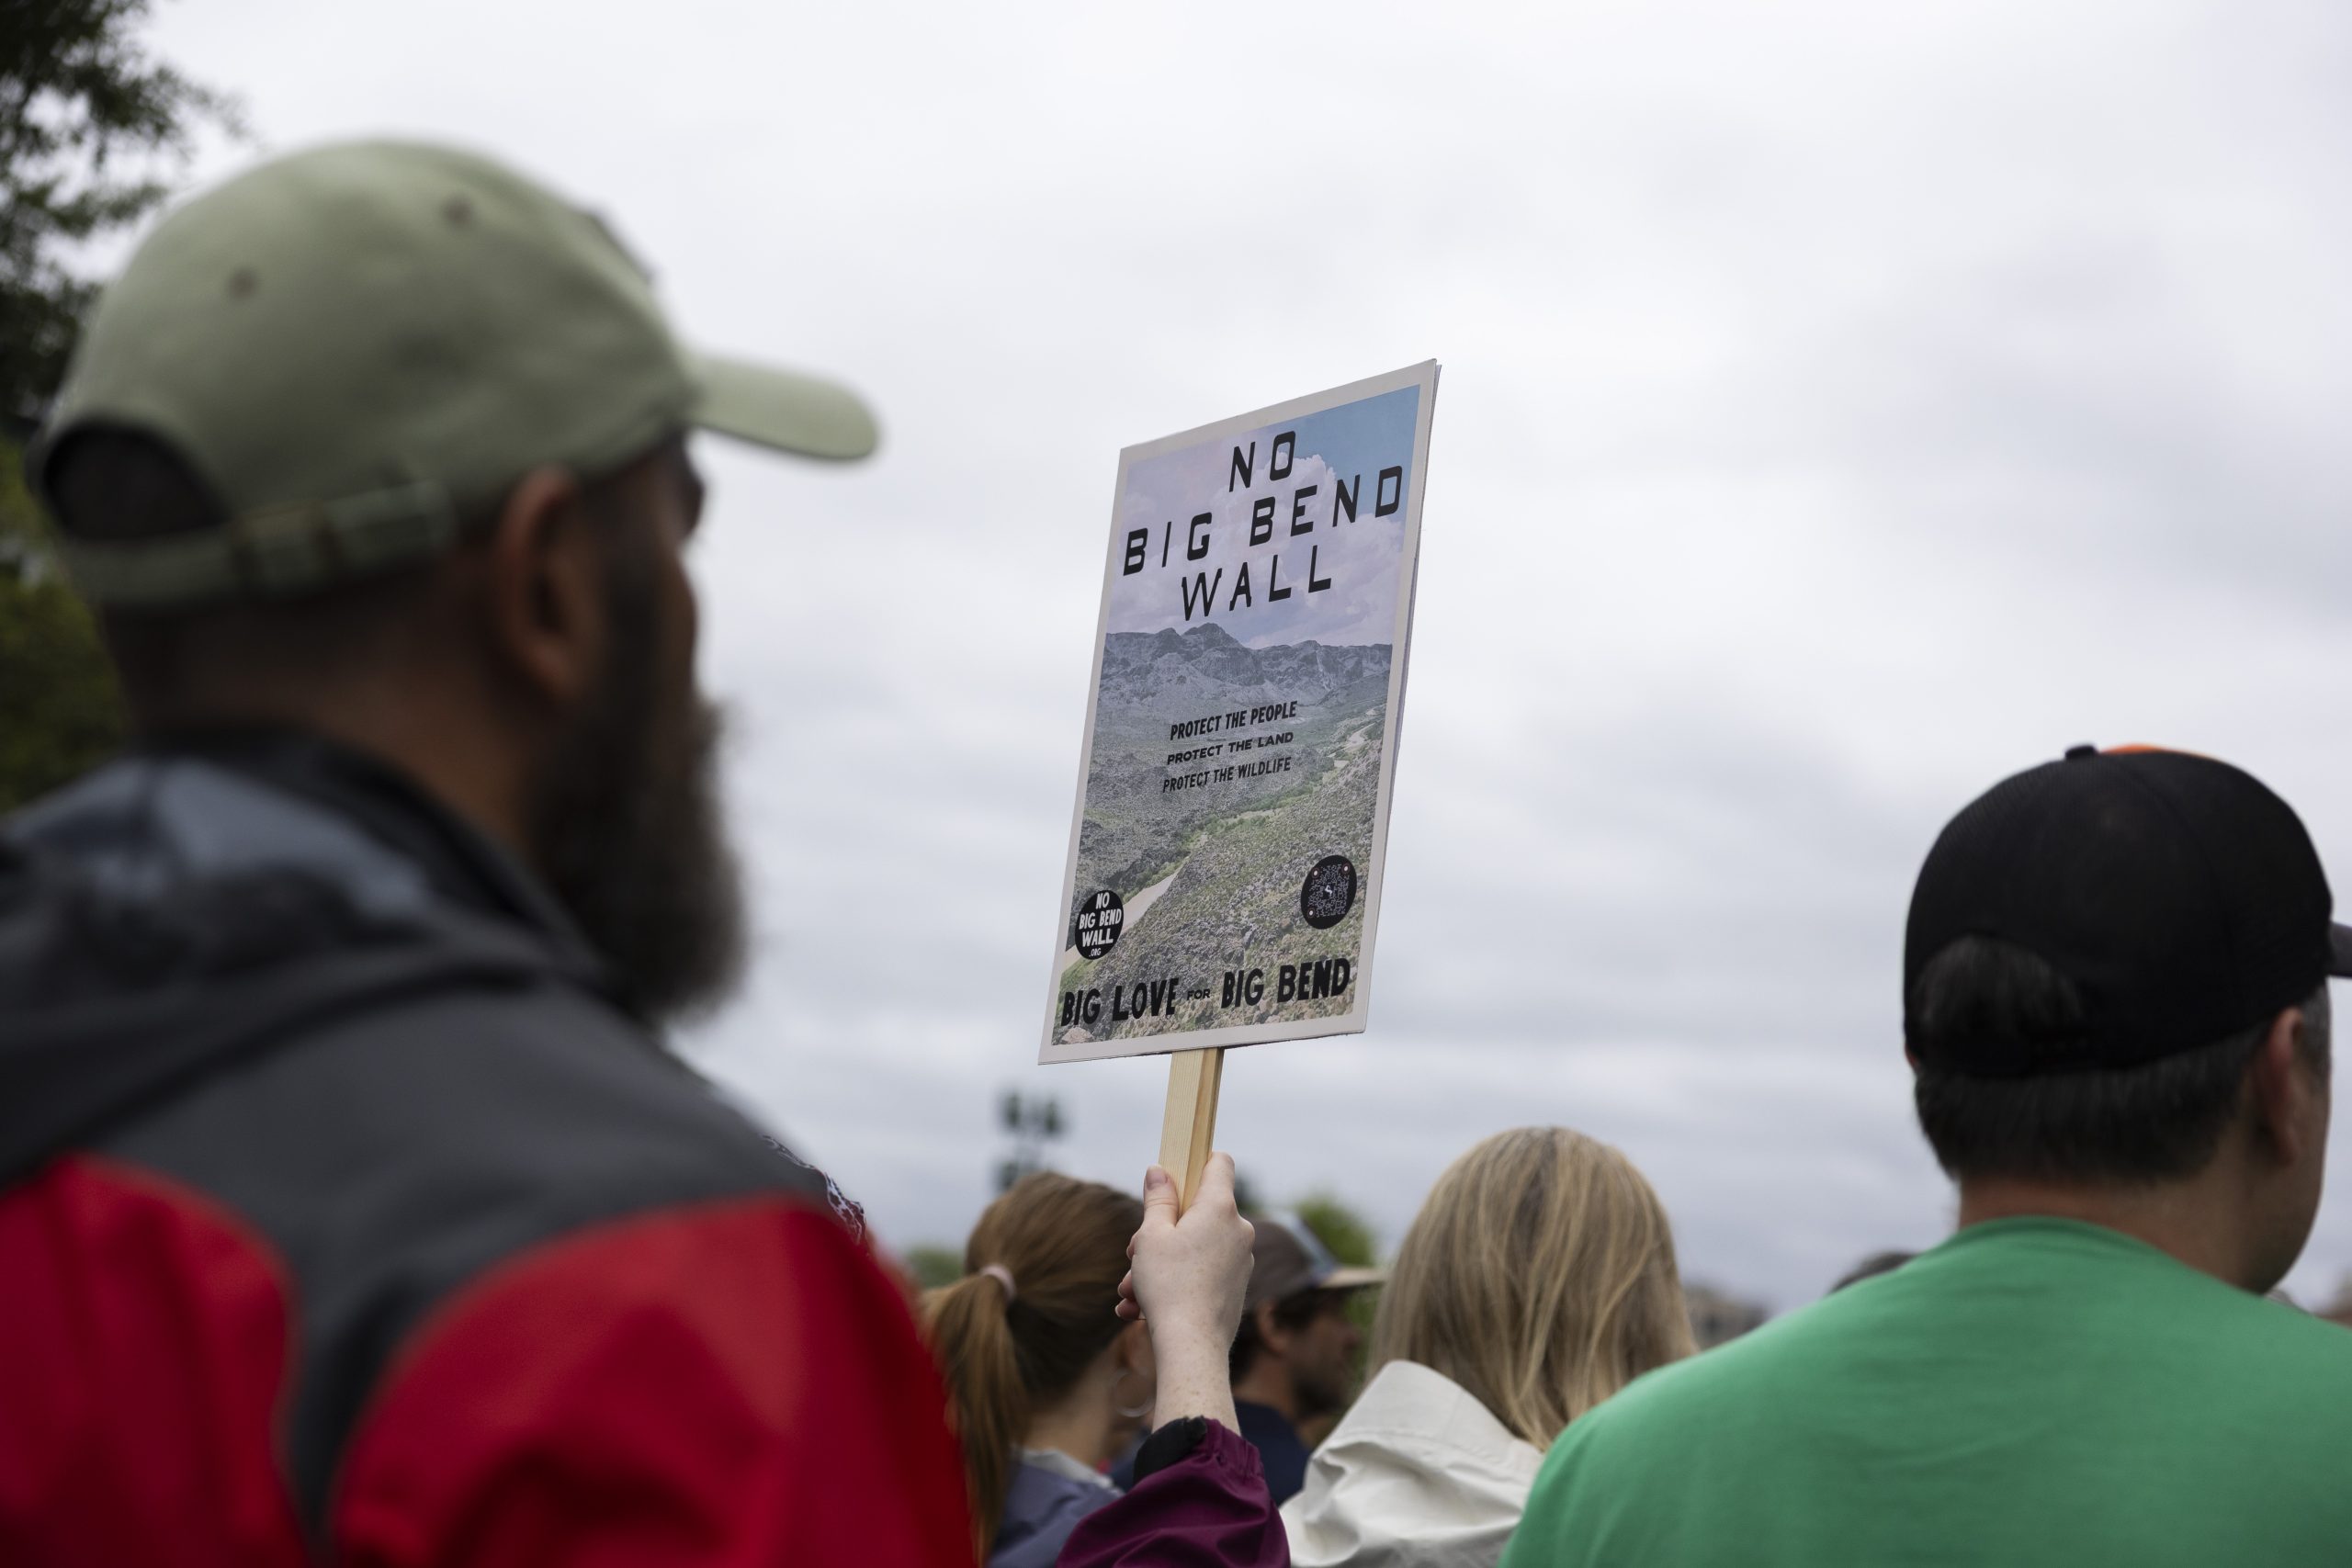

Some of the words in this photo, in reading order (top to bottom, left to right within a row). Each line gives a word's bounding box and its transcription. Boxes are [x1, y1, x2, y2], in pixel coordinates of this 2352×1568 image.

[1229, 431, 1295, 491] NO
[1124, 513, 1212, 576] BIG
[1250, 466, 1402, 547] BEND
[1182, 545, 1332, 621] WALL
[1170, 716, 1222, 740] PROTECT
[1226, 710, 1248, 729] THE
[1250, 701, 1297, 725] PEOPLE
[1167, 745, 1223, 765] PROTECT
[1228, 739, 1252, 752] THE
[1258, 732, 1294, 748] LAND
[1163, 771, 1210, 793] PROTECT
[1214, 766, 1234, 784] THE
[1238, 756, 1291, 779] WILDLIFE
[1096, 892, 1110, 908] NO
[1079, 912, 1096, 930] BIG
[1099, 909, 1122, 926] BEND
[1082, 928, 1114, 947] WALL
[1061, 988, 1101, 1026] BIG
[1113, 977, 1180, 1021] LOVE
[1187, 989, 1211, 1000] FOR
[1221, 968, 1264, 1009] BIG
[1277, 958, 1351, 1003] BEND
